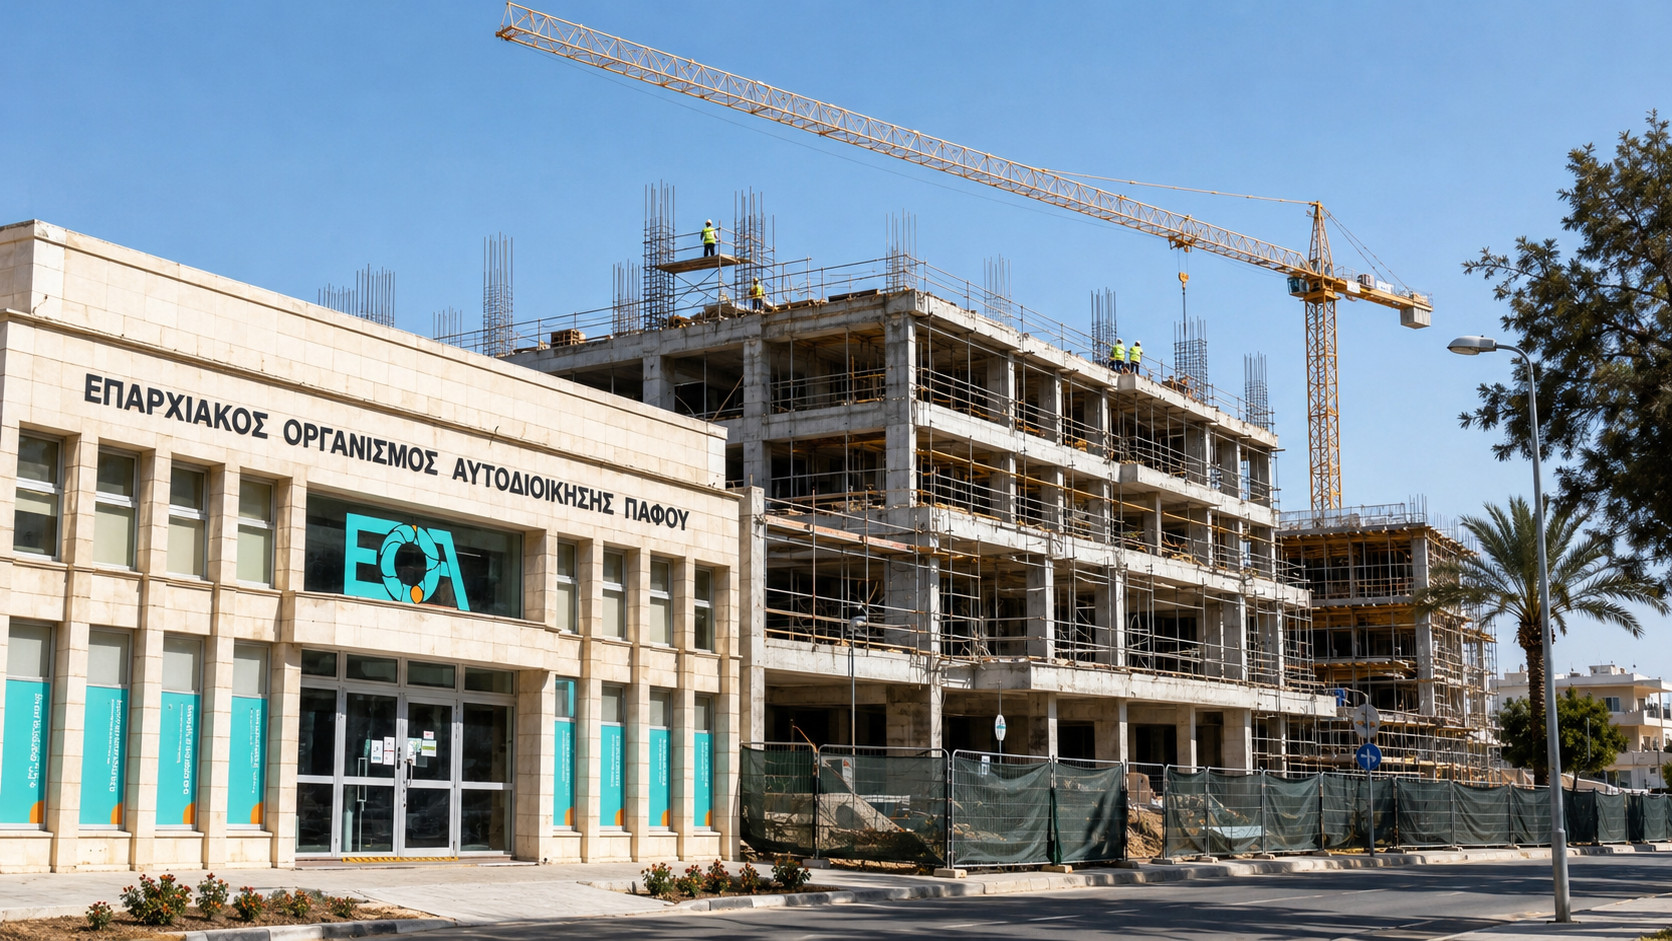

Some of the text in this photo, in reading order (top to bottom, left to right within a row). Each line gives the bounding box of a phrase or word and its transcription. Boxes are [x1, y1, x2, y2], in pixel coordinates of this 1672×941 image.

[85, 373, 689, 531] ΕΠΑΡΧΙΑΚΟΣ ΟΡΓΑΝΙΣΜΟΣ ΑΥΤΟΔΙΟΙΚΗΣΗΣ ΠΑΦΟΥ
